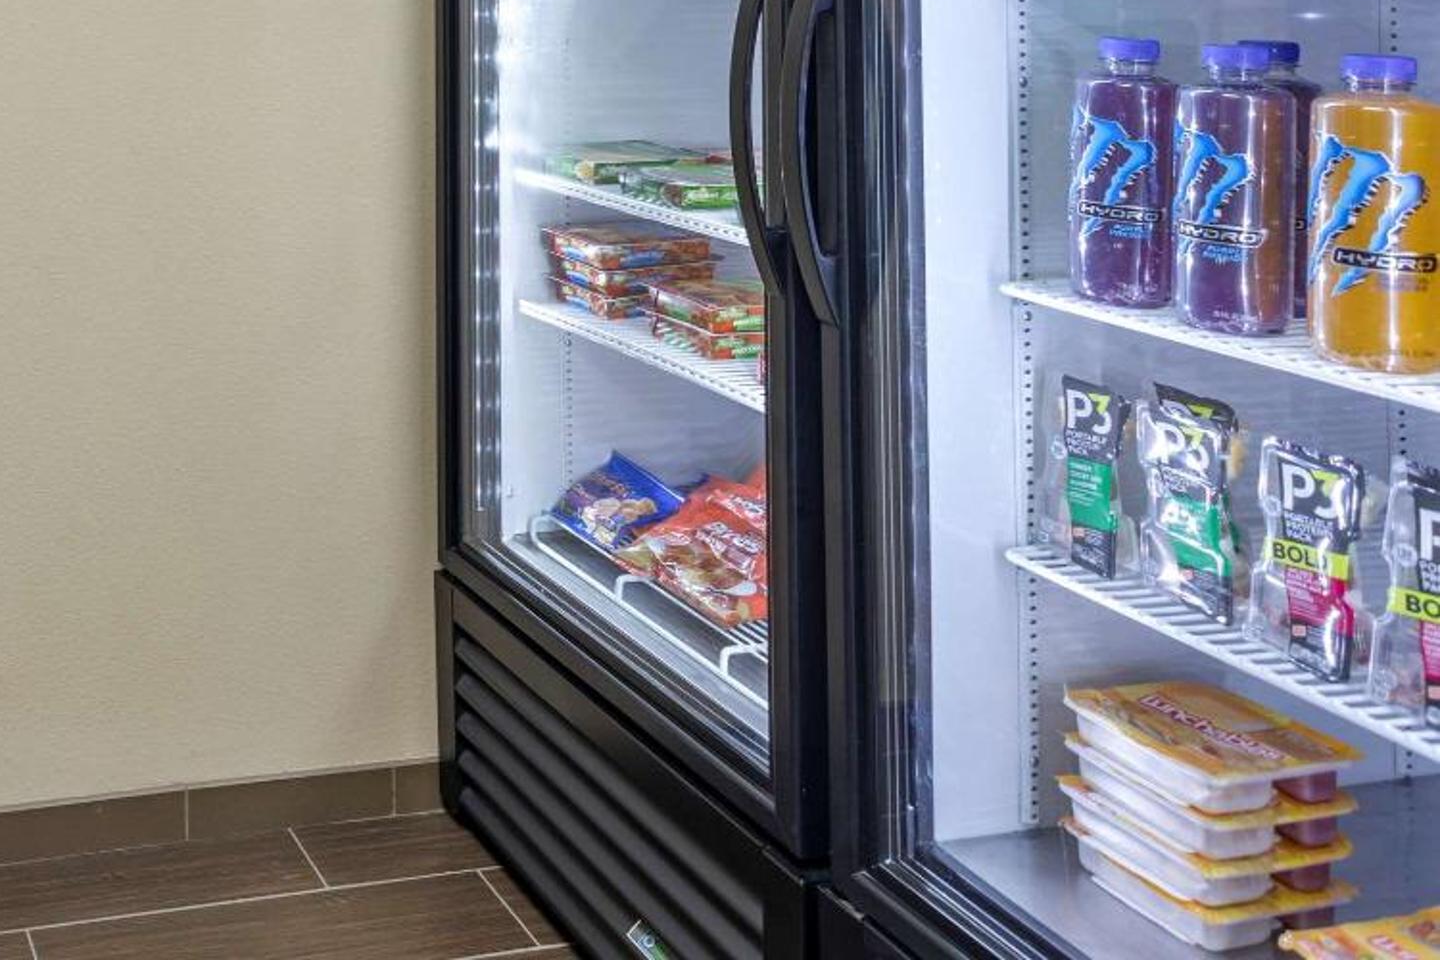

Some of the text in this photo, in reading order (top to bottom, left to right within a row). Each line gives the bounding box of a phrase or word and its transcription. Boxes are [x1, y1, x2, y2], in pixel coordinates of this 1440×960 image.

[1080, 203, 1160, 223] HYDRO
[1179, 224, 1258, 244] HYDRO
[1334, 250, 1434, 272] HYDRO
[1065, 389, 1112, 435] P3
[1282, 463, 1340, 521] P3
